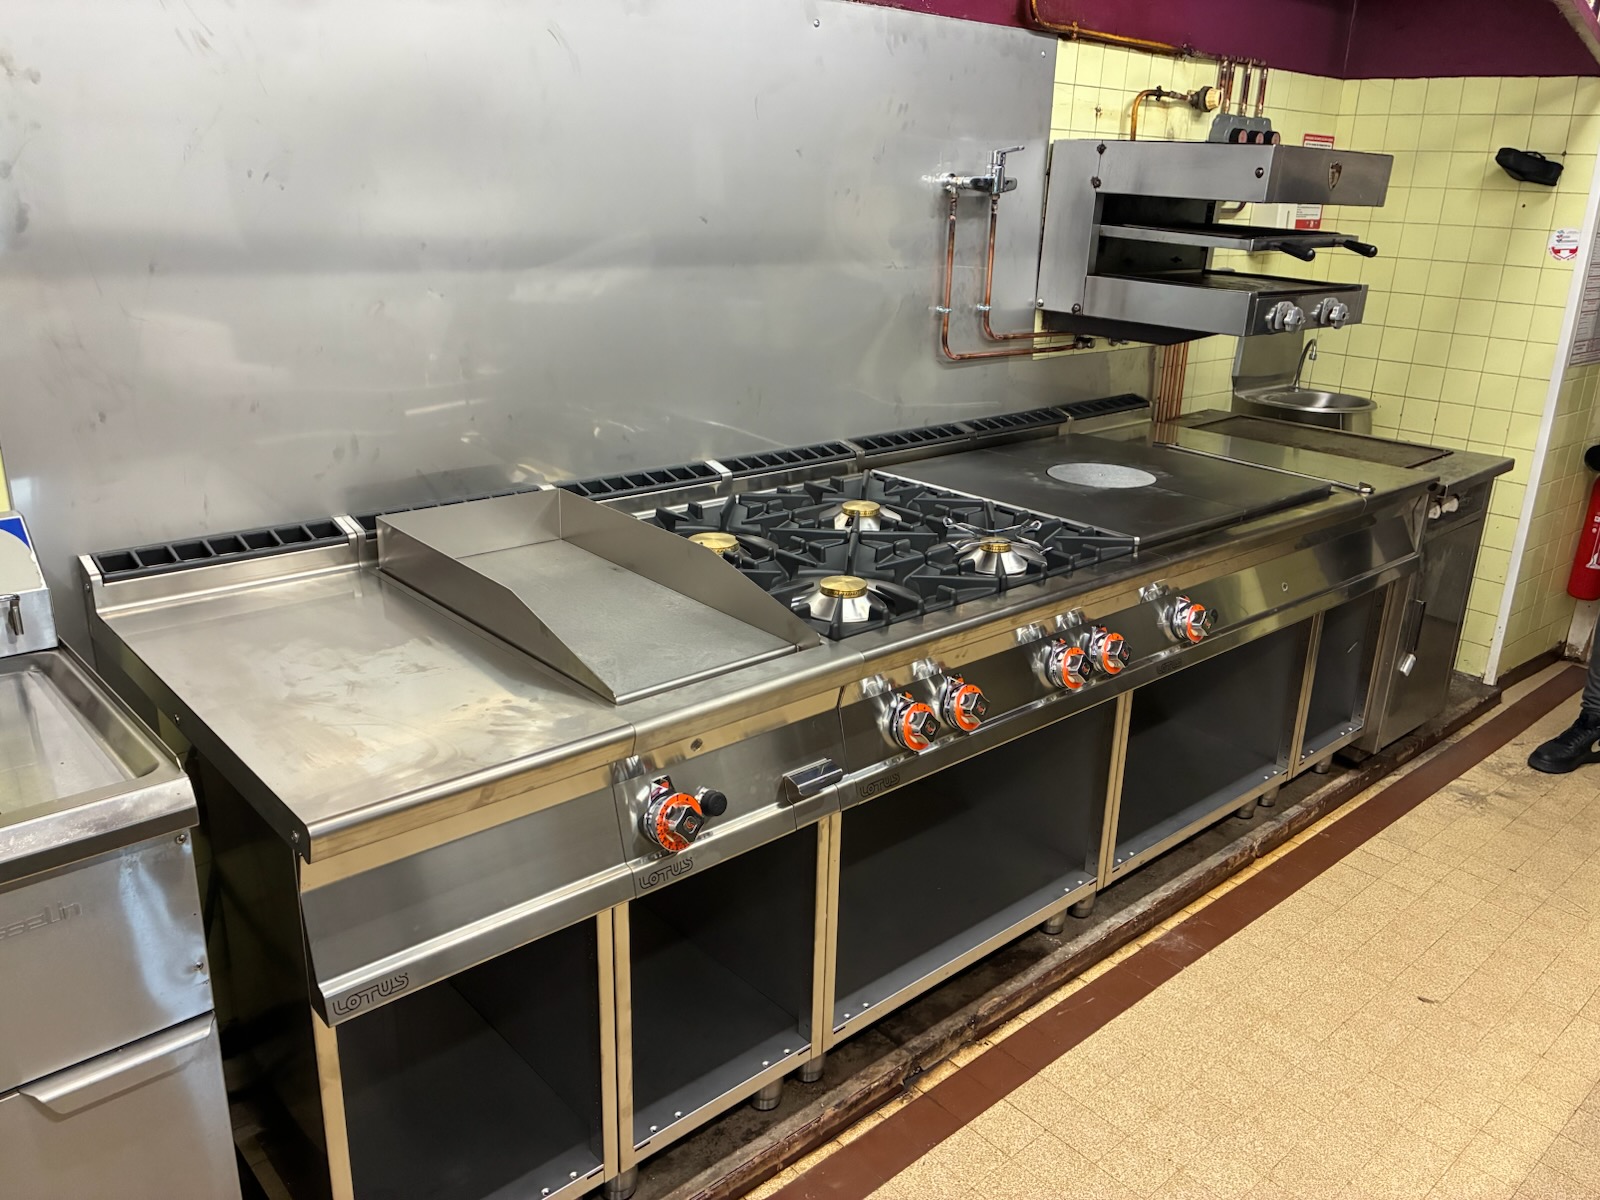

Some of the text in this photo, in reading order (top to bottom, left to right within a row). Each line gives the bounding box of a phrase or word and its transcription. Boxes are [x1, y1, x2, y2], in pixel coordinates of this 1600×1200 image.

[860, 773, 900, 798] LOTUS
[639, 857, 694, 889] LOTUS
[332, 972, 409, 1016] LOTUS
